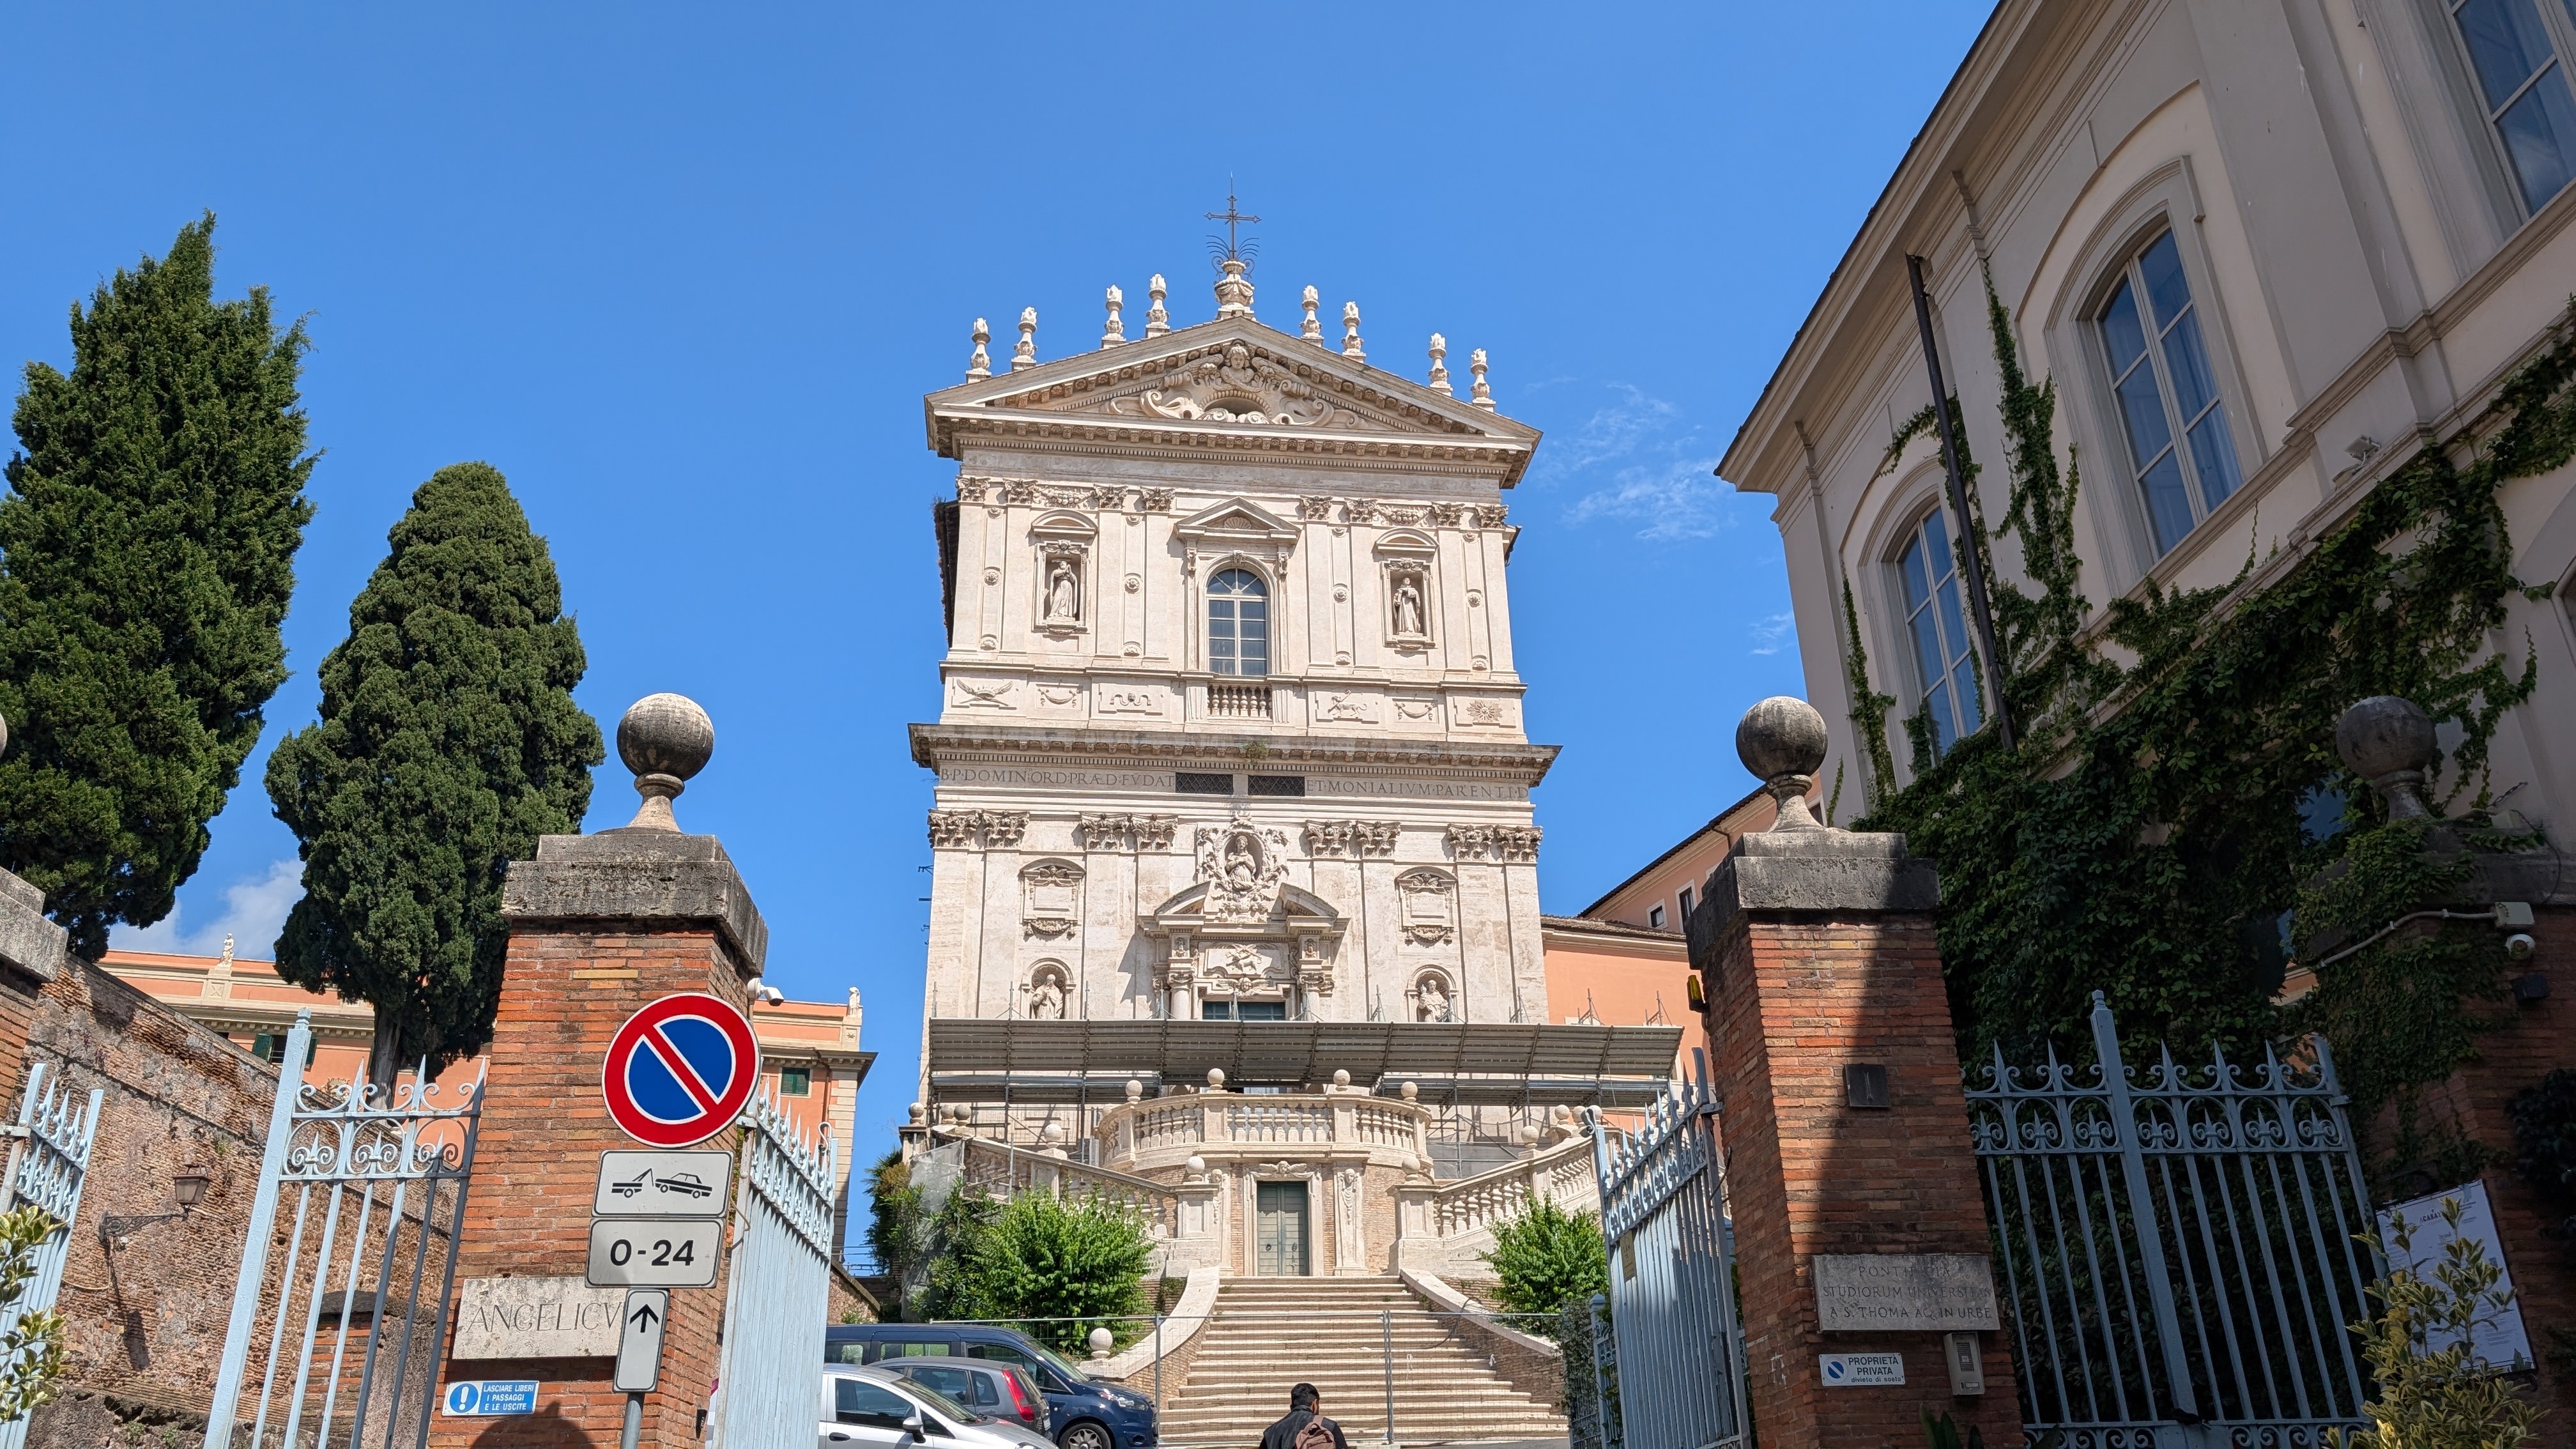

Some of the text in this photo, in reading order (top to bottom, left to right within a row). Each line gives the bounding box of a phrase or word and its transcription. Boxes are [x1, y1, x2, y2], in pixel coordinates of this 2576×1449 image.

[1859, 1266, 1950, 1278] PONTIFICIA
[1823, 1286, 1992, 1298] STUDIORUM UNIVERSITAS
[467, 1301, 624, 1333] ANGELICV
[1830, 1307, 1838, 1317] A
[1844, 1307, 1855, 1317] S.
[1858, 1307, 1909, 1317] THOMA
[1940, 1307, 1953, 1317] IN
[1958, 1307, 1993, 1319] URBE
[1856, 1367, 1894, 1375] PRIVATA
[514, 1384, 535, 1392] LIBERI
[502, 1402, 527, 1411] USCITE
